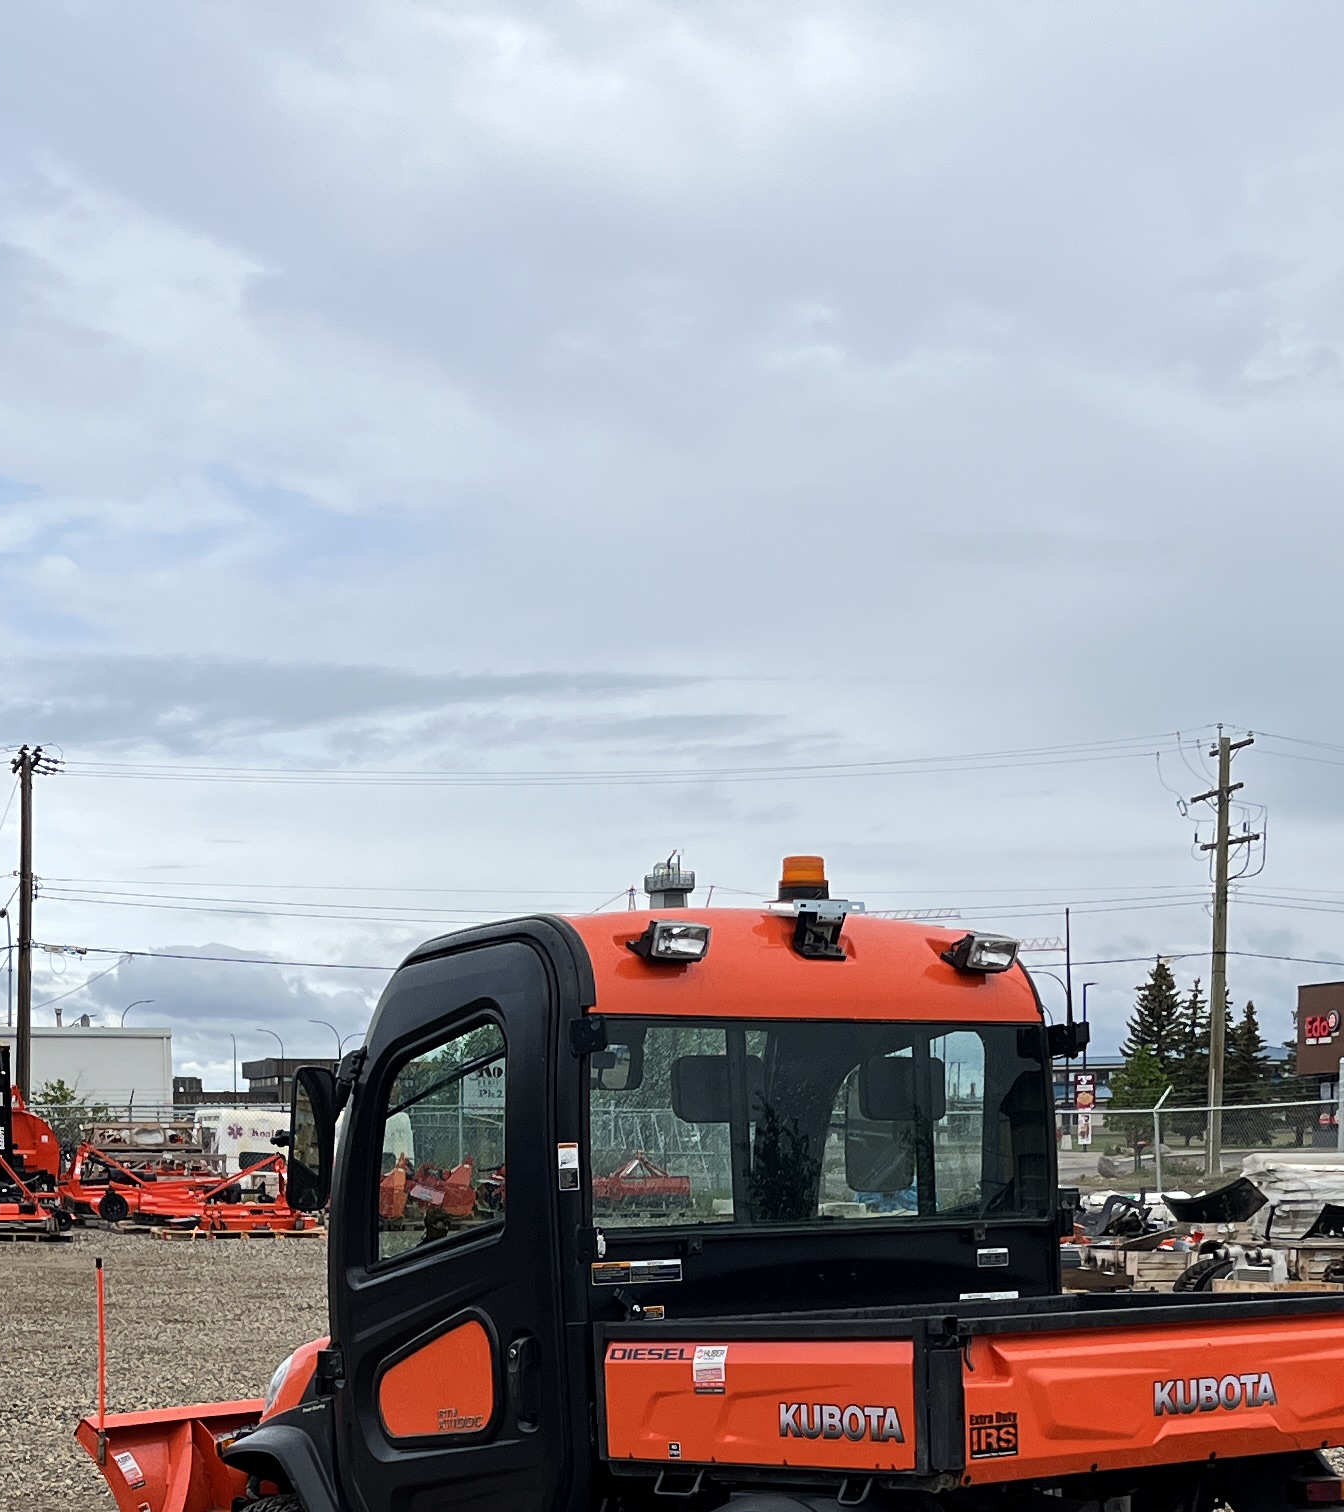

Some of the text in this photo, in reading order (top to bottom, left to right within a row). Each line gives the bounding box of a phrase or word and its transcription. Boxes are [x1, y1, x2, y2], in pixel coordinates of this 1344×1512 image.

[1305, 1014, 1329, 1037] Edo
[610, 1348, 693, 1361] DIESEL
[1153, 1372, 1277, 1415] KUBOTA
[779, 1402, 905, 1443] KUBOTA
[972, 1427, 1016, 1450] IRS
